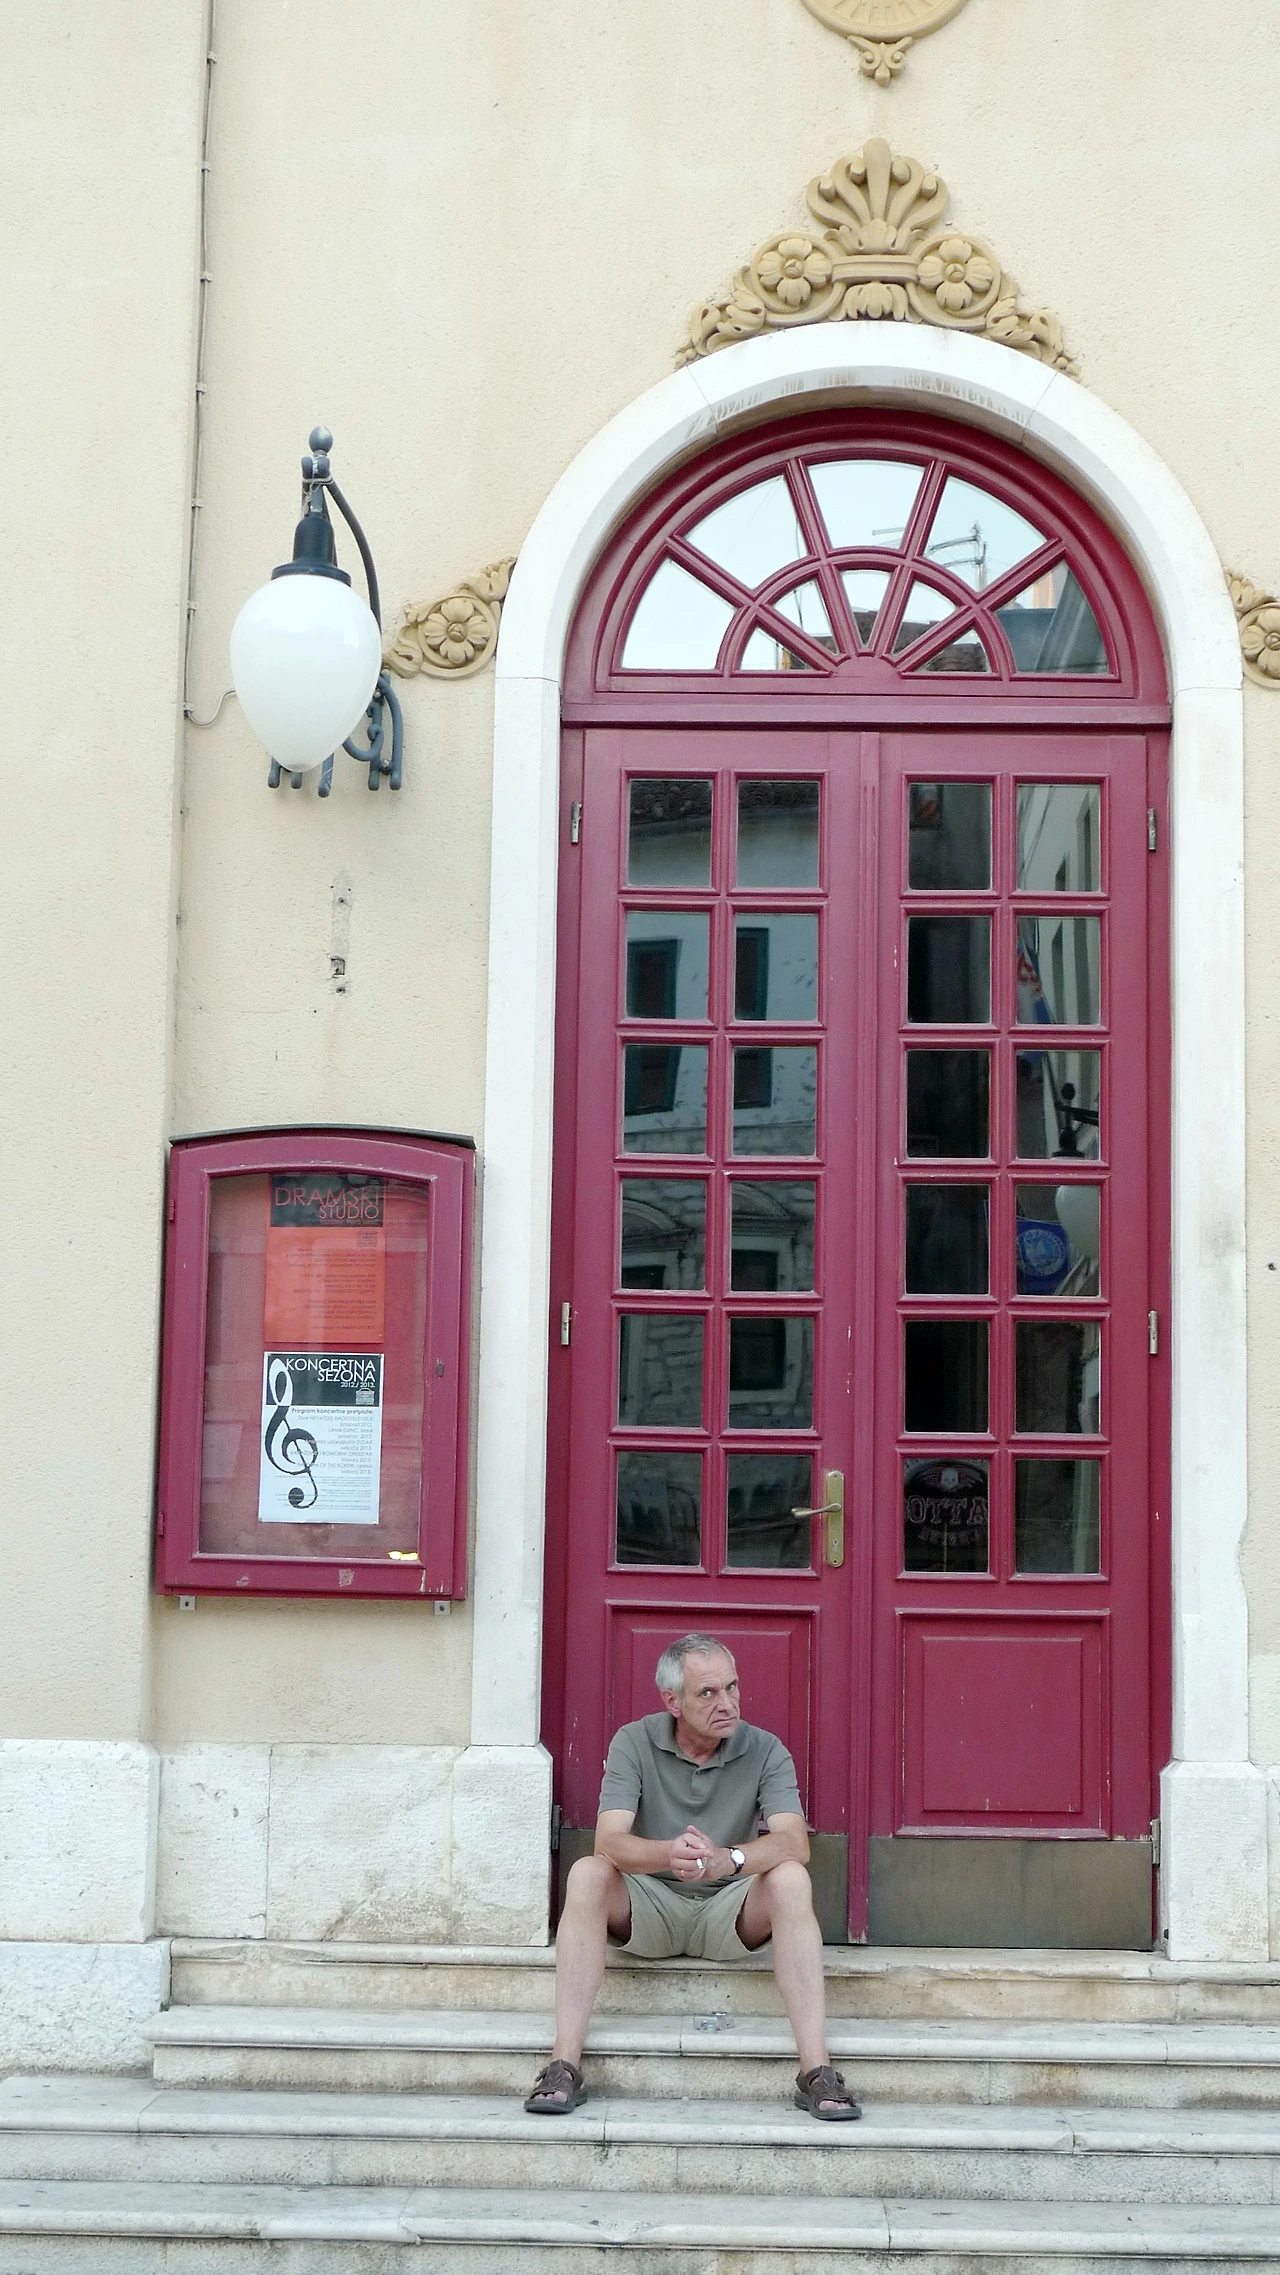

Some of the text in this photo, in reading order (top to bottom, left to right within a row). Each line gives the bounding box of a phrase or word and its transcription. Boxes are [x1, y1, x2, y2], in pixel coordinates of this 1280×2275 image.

[275, 1187, 379, 1206] DRAMSKI
[319, 1204, 379, 1219] STUDIO
[286, 1358, 376, 1371] KONCERTNA
[317, 1369, 376, 1382] SEZONA
